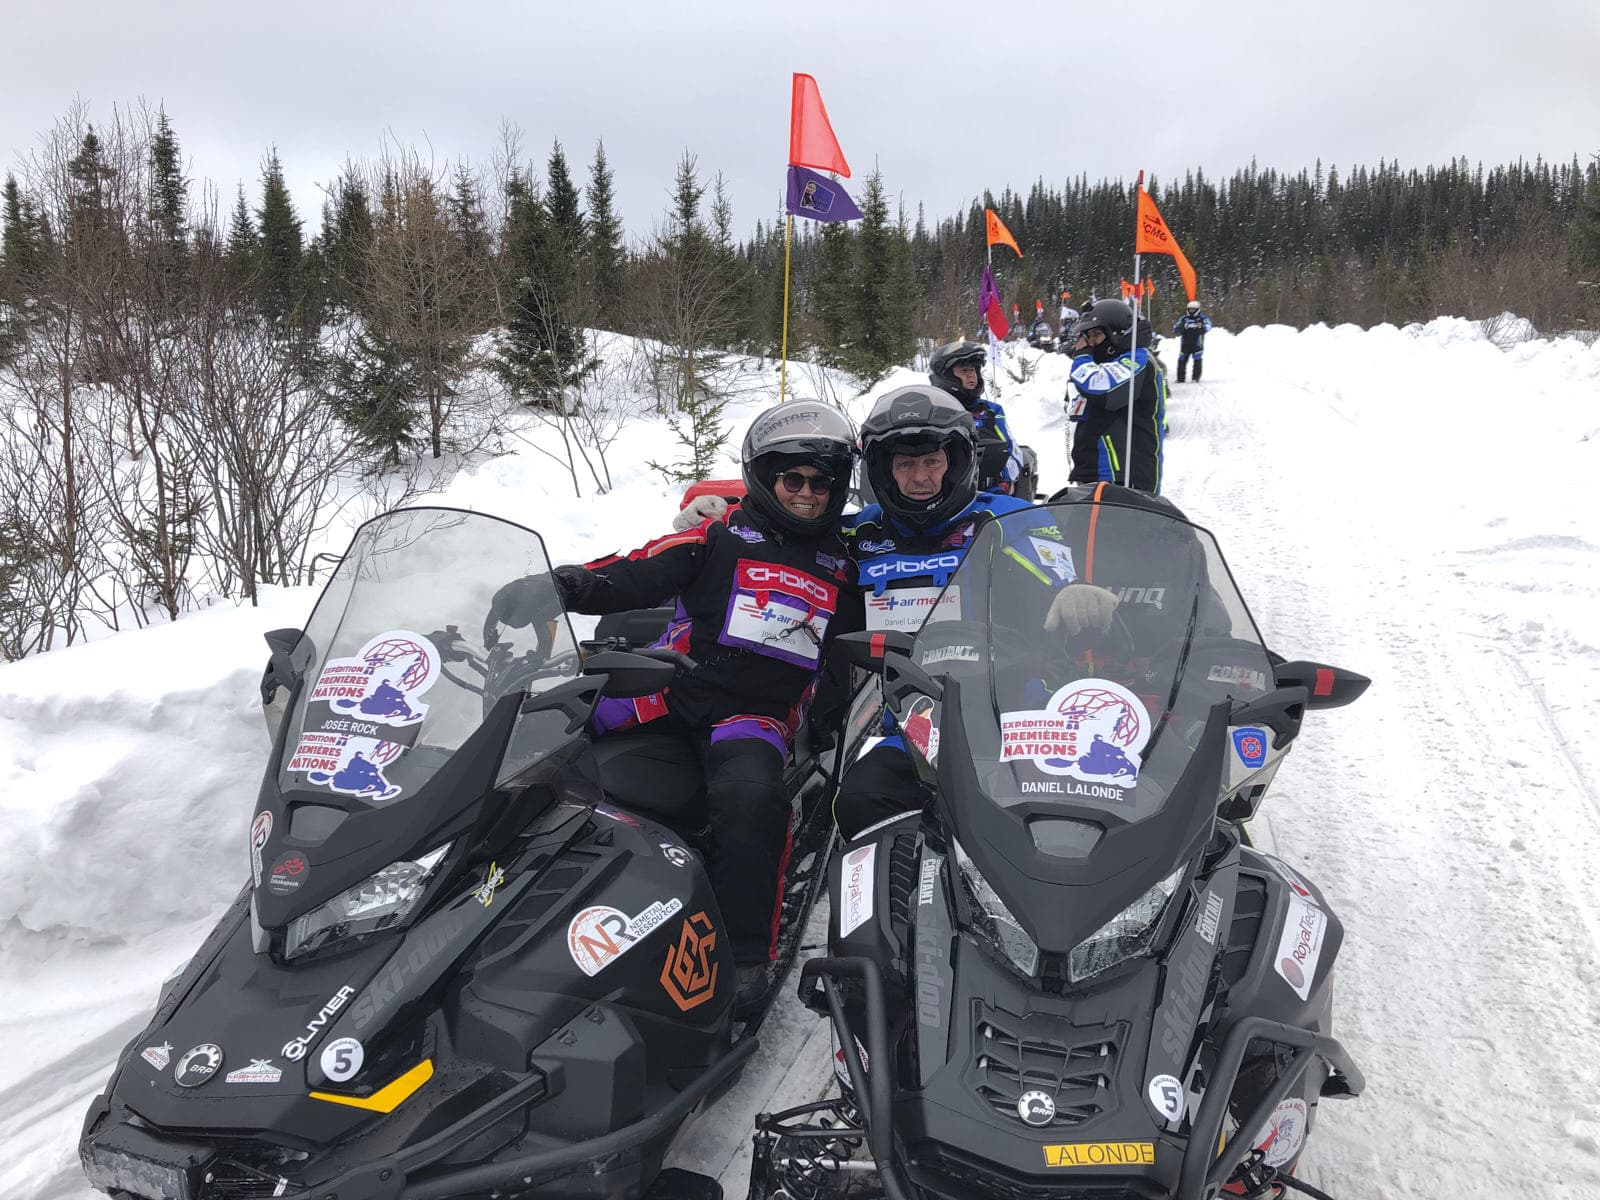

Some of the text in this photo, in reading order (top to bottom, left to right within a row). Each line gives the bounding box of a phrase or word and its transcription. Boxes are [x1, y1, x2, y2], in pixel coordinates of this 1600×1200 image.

[866, 555, 959, 577] CHOKO
[746, 567, 829, 602] CHOKO
[312, 686, 365, 698] NATIONS
[321, 718, 379, 736] JOSÉE ROCK
[1002, 720, 1065, 730] EXPÉDITION
[1003, 730, 1077, 742] PREMIÈRES
[1003, 743, 1078, 757] NATIONS
[1021, 781, 1125, 801] DANIEL LALONDE
[921, 858, 936, 904] CONTANT
[629, 903, 663, 931] NEMETAU
[634, 900, 680, 937] RESSOURCES
[1199, 890, 1222, 943] CONTANT
[189, 1064, 214, 1074] BRP
[333, 1048, 353, 1074] 5
[1031, 1106, 1053, 1116] BRP
[1161, 1087, 1178, 1114] 5
[1044, 1143, 1154, 1166] LALONDE
